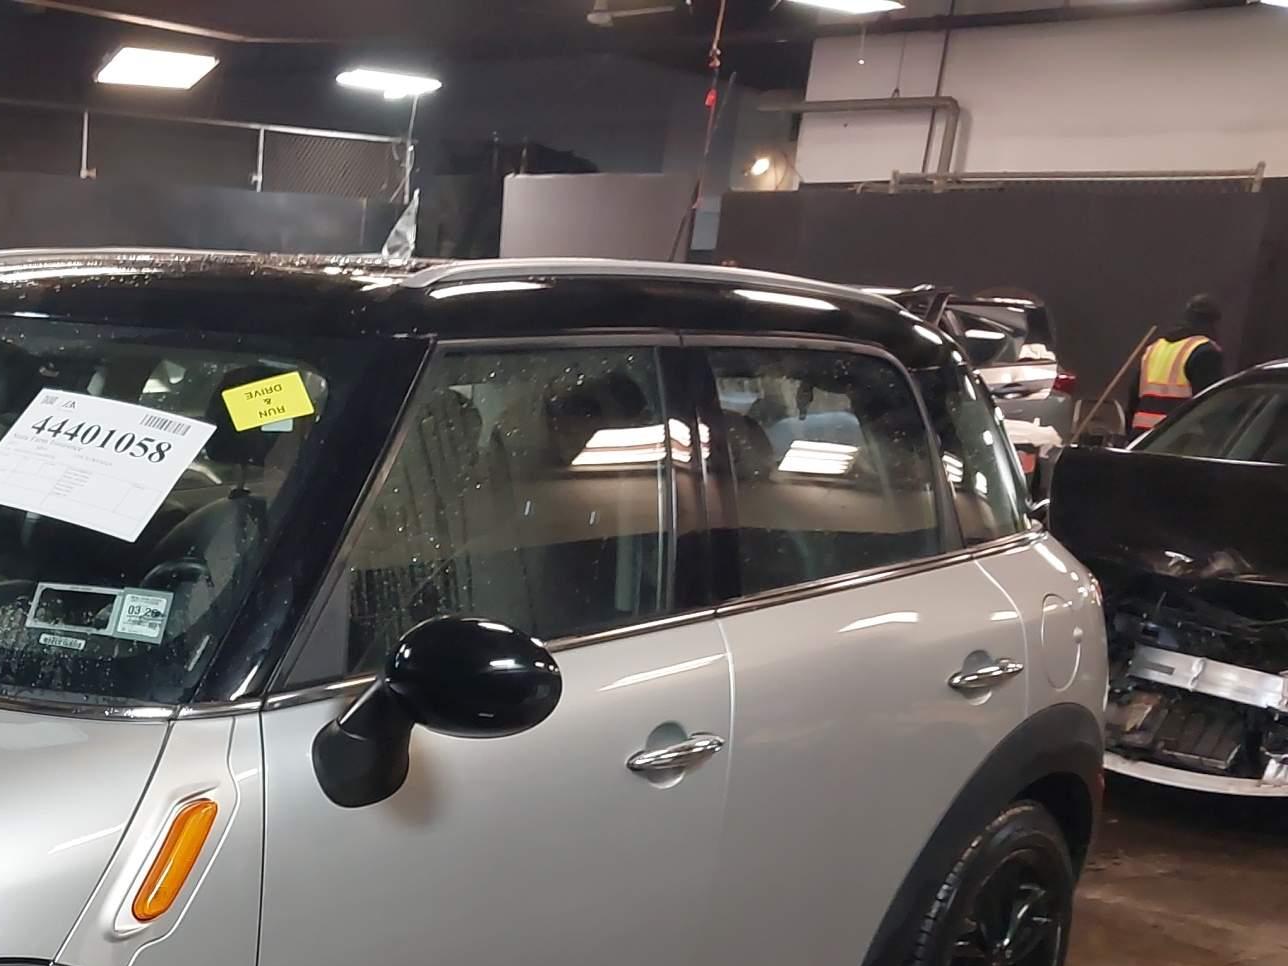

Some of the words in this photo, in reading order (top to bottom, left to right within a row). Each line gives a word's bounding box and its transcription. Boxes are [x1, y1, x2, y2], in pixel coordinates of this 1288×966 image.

[244, 383, 283, 400] DRIVE
[258, 405, 286, 418] RUN
[31, 415, 172, 463] 44401058
[127, 605, 141, 615] 03
